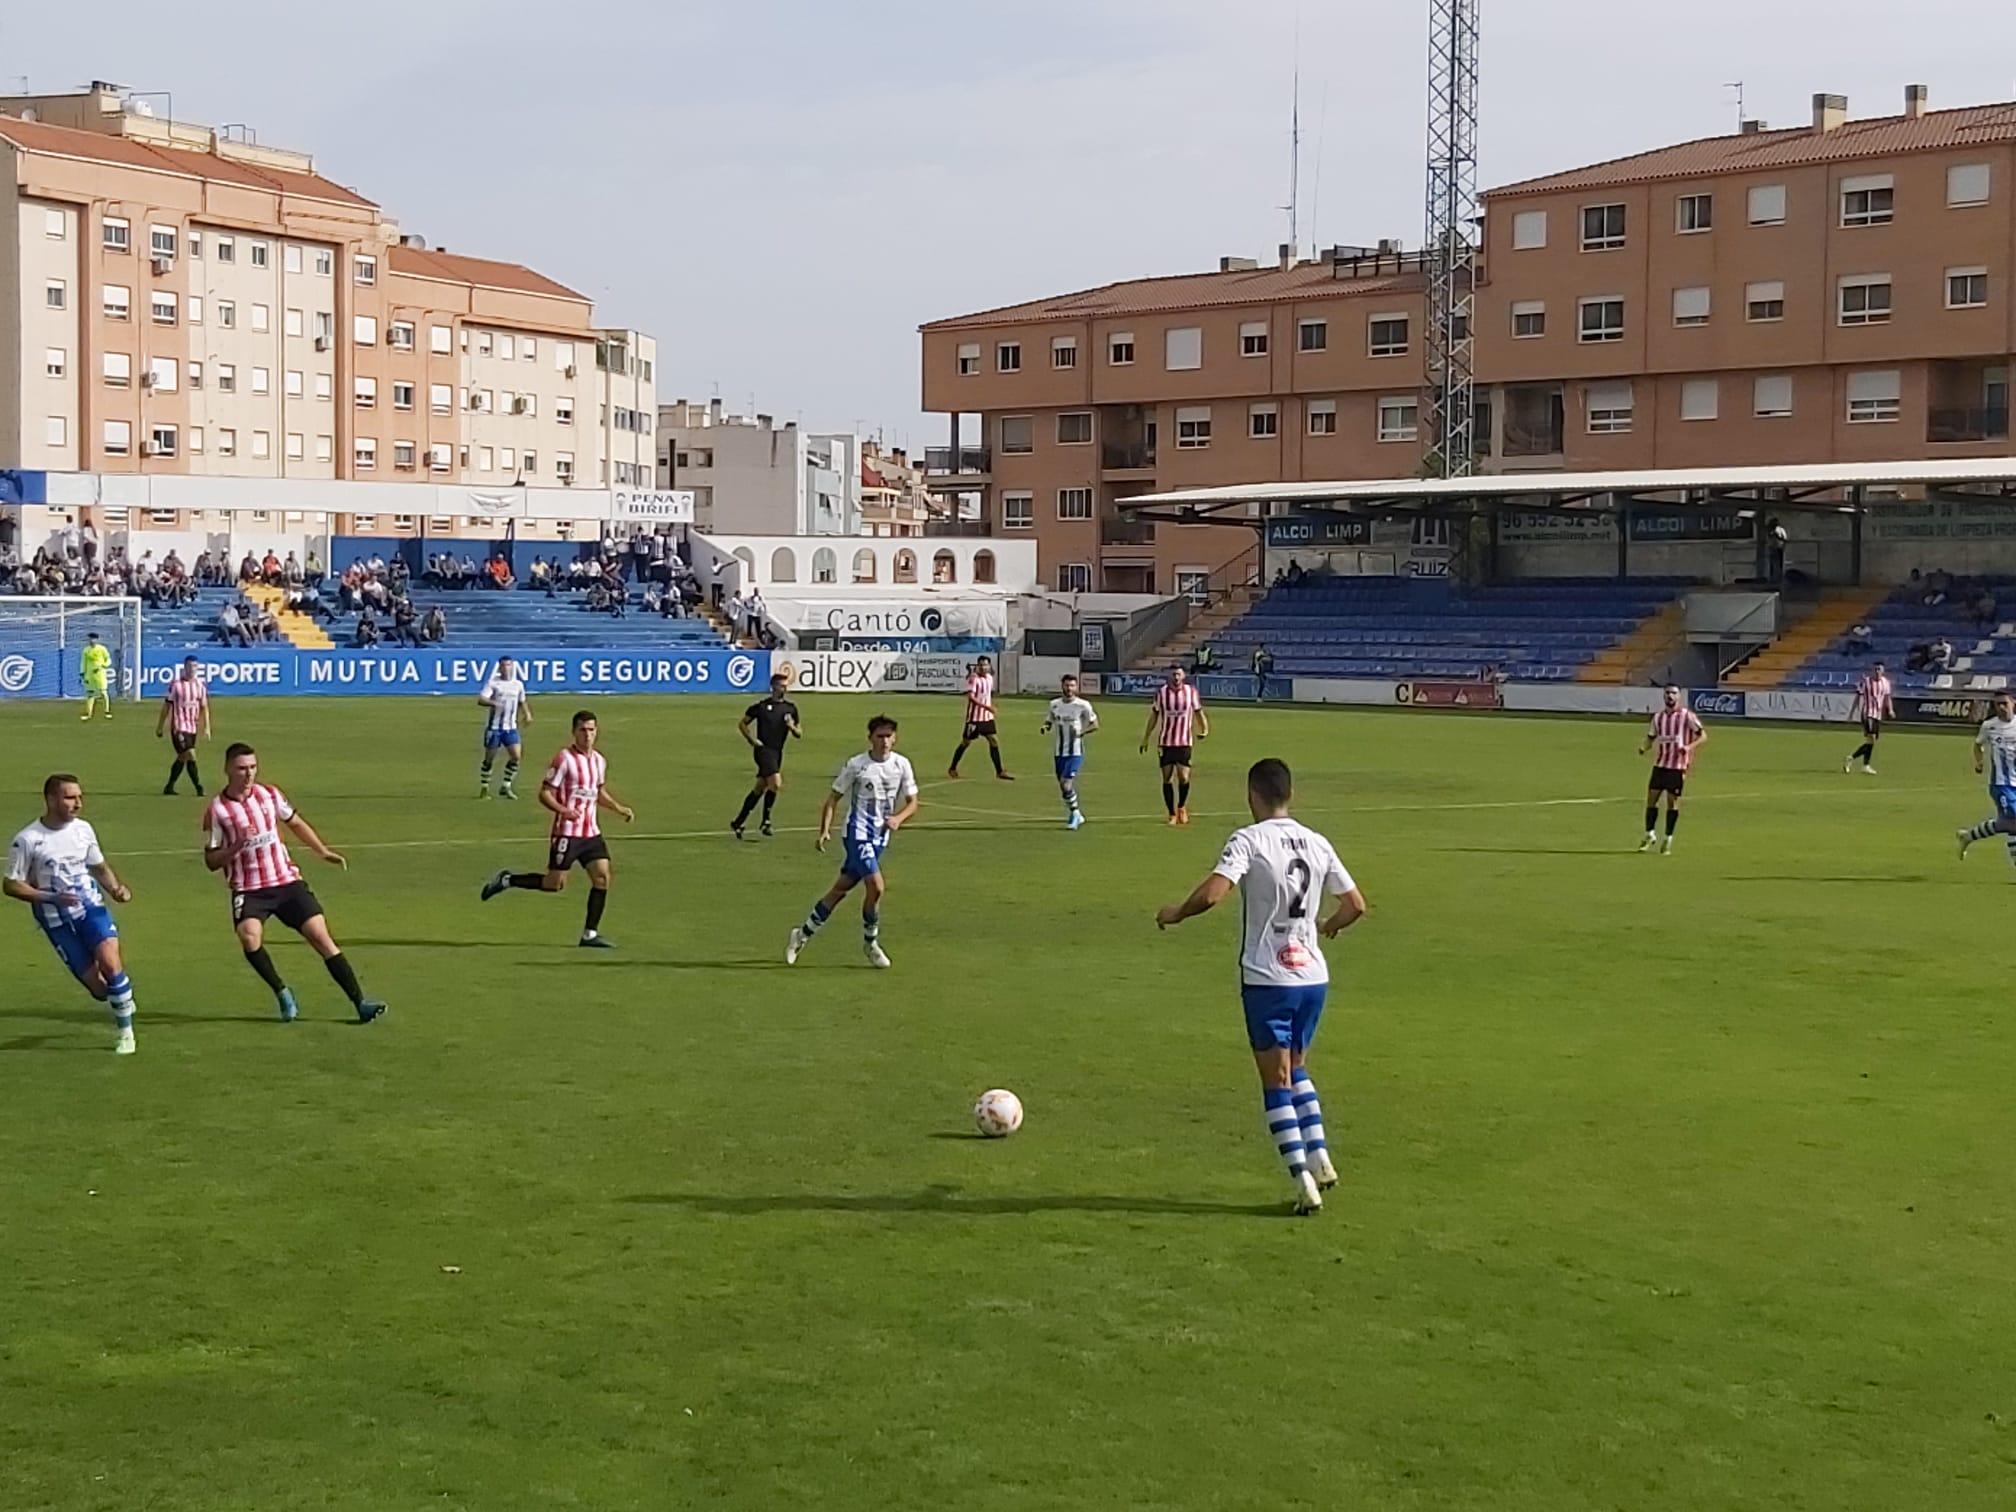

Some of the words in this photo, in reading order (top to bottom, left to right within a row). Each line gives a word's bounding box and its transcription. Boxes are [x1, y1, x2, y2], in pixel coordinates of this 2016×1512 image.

[1272, 526, 1313, 539] ALCOI
[1326, 524, 1362, 539] LIMP
[1635, 517, 1684, 533] ALCOI
[1700, 517, 1742, 531] LIMP
[827, 608, 911, 632] Cantó
[841, 640, 892, 652] Desde
[896, 641, 929, 653] 1940
[310, 660, 420, 682] MUTUA
[580, 660, 709, 682] SEGUROS
[800, 654, 873, 688] aitex
[557, 838, 568, 853] 8
[1287, 858, 1311, 918] 2
